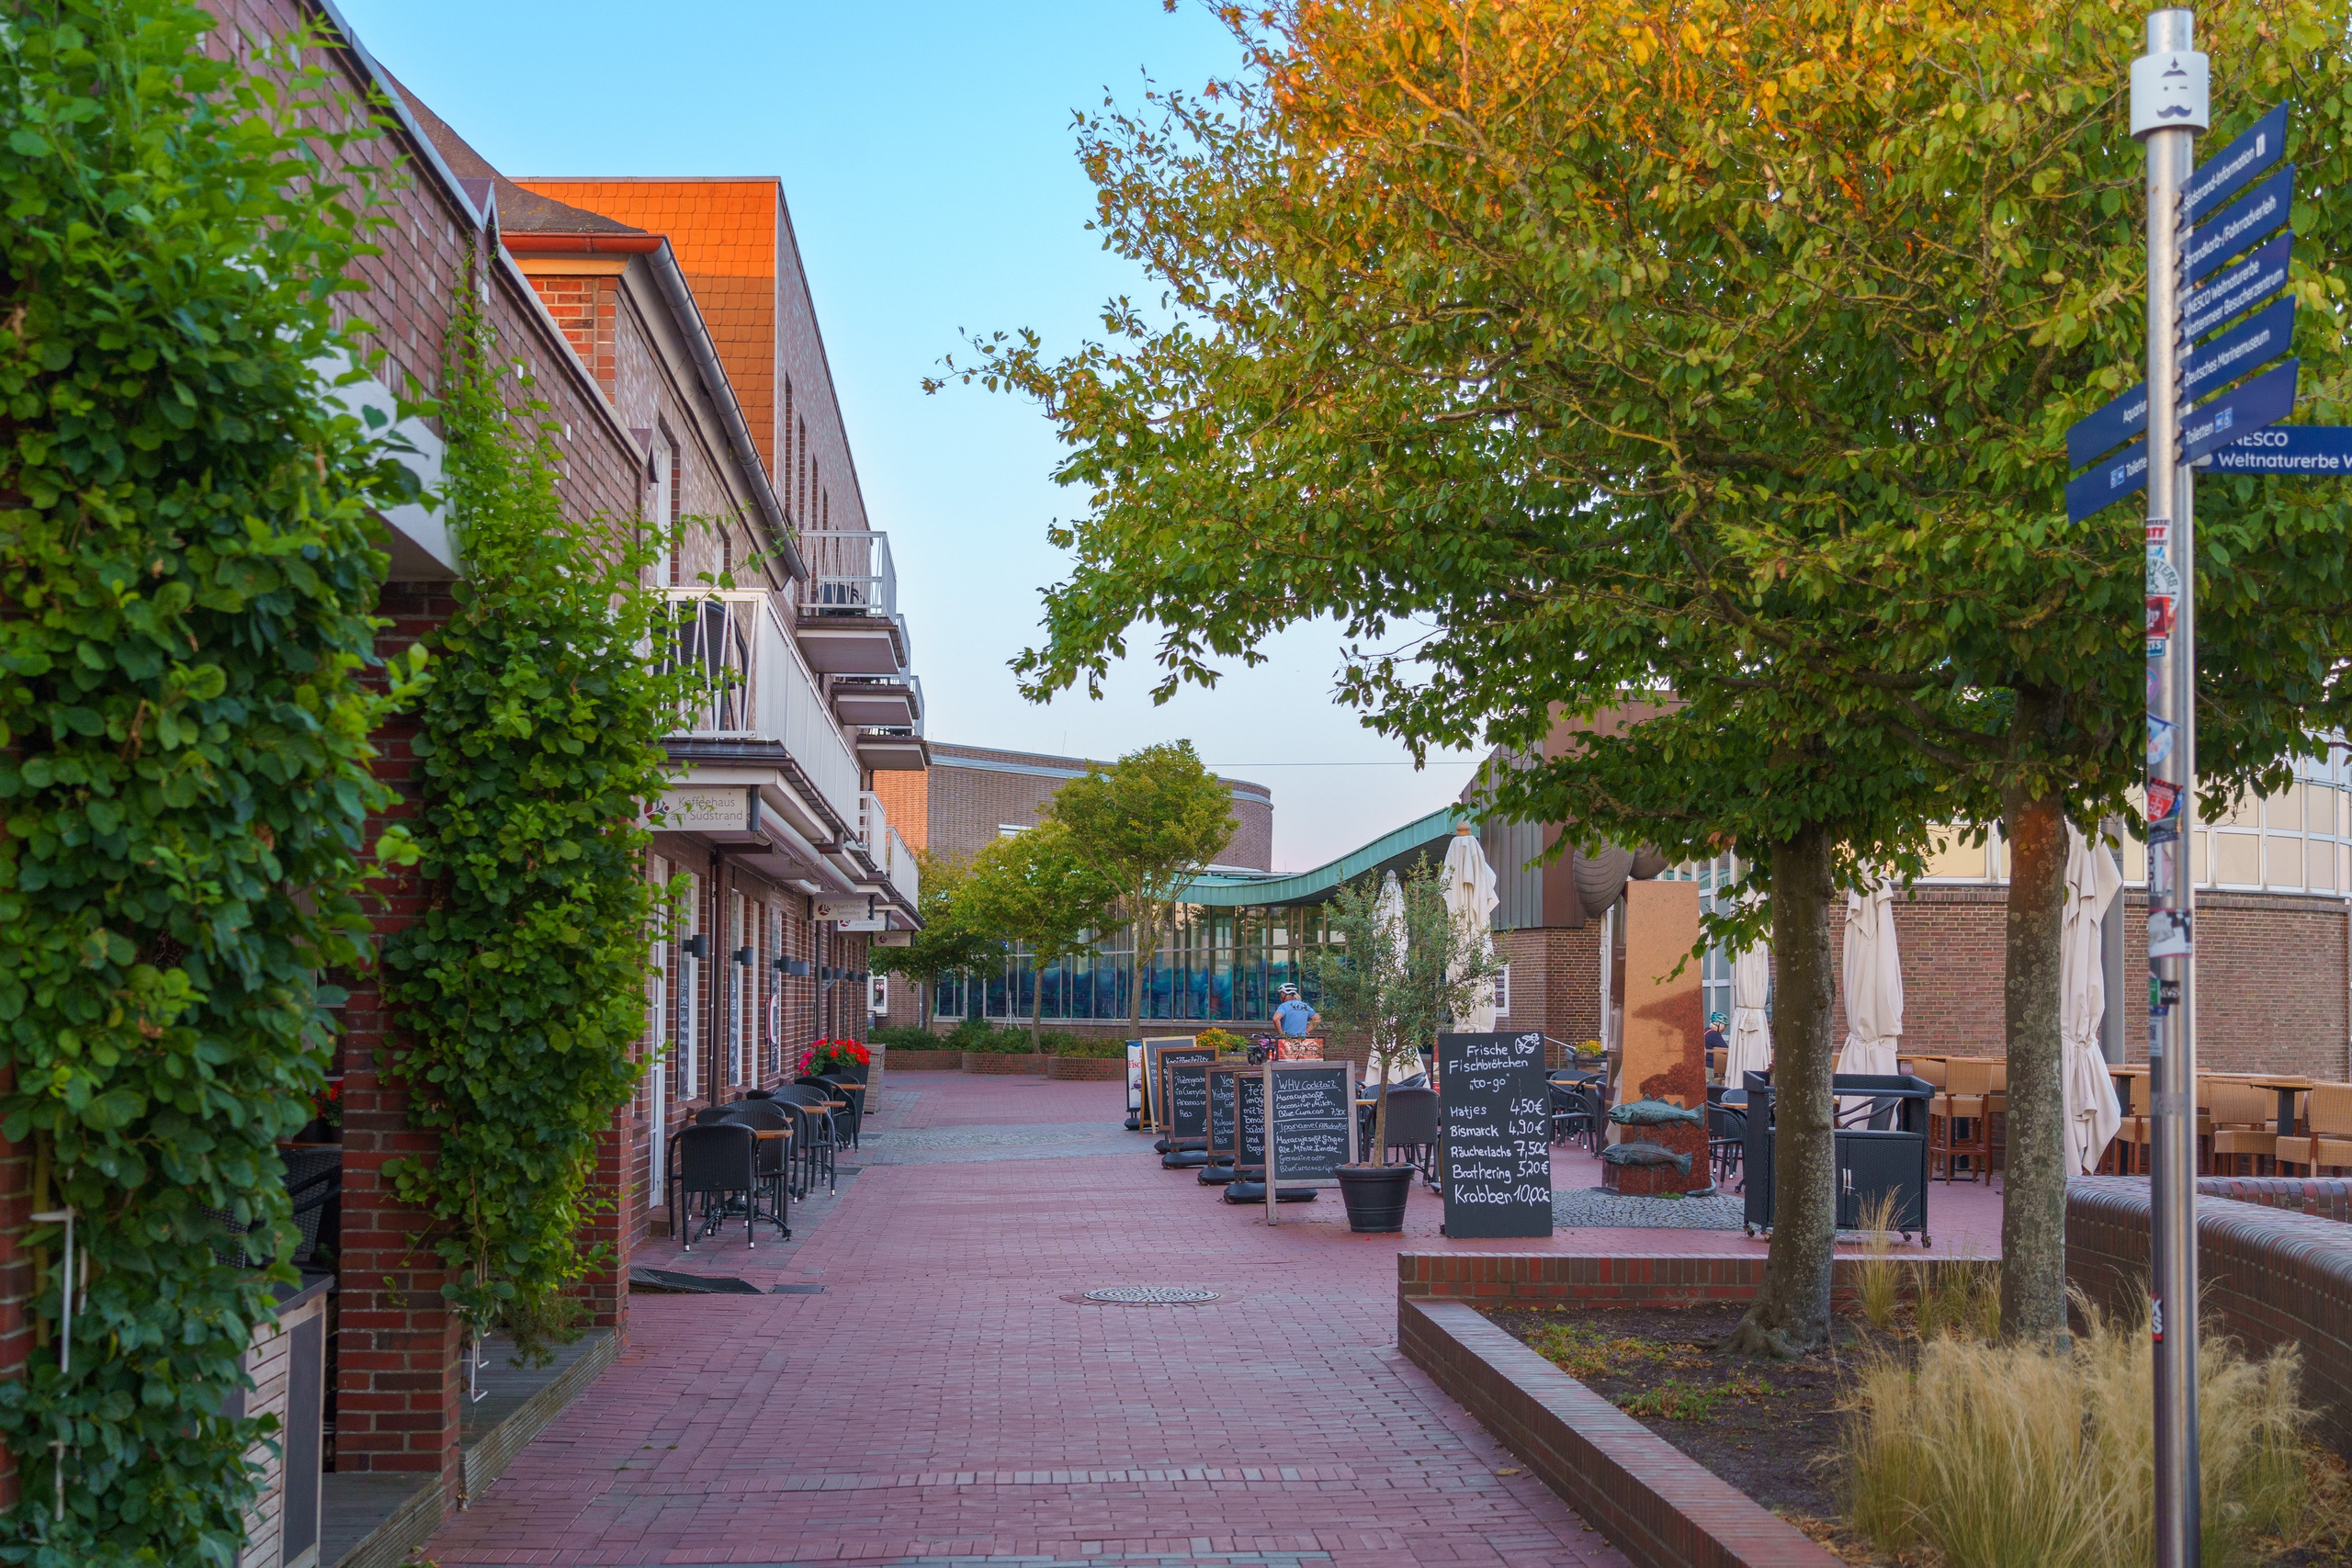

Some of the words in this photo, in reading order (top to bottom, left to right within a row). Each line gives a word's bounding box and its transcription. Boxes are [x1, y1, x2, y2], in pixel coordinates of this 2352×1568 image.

[2184, 147, 2255, 211] Südstrand-Information
[2184, 195, 2277, 270] Strandkorb-/Fahrradverleih
[2184, 289, 2211, 318] UNESCO
[2211, 260, 2260, 300] Weltnaturerbe
[2184, 305, 2223, 339] Wattenmeer
[2223, 268, 2284, 315] Besucherzentrum
[2185, 358, 2217, 387] Deutsches
[2217, 328, 2271, 367] Marinemuseum
[2185, 423, 2214, 446] Toiletten
[2230, 432, 2289, 446] ESCO
[2126, 457, 2147, 478] Toilette
[2218, 452, 2339, 468] Weltnaturerbe
[678, 796, 736, 807] Kaffeehaus
[671, 812, 686, 820] am
[690, 809, 743, 820] Südstrand
[1467, 1042, 1509, 1057] Frische
[1449, 1056, 1529, 1075] Fischbrötchen
[1279, 1078, 1300, 1089] WHV
[1450, 1105, 1487, 1120] Matjes
[1510, 1098, 1545, 1116] 4,50€
[1450, 1124, 1499, 1137] Bismarck
[1509, 1120, 1544, 1136] 4,90€
[1246, 1145, 1265, 1156] Bagu
[1451, 1145, 1511, 1158] Räucherlachs
[1513, 1139, 1548, 1161] 7,50€
[1453, 1162, 1511, 1184] Brathering
[1454, 1184, 1512, 1204] Krabben
